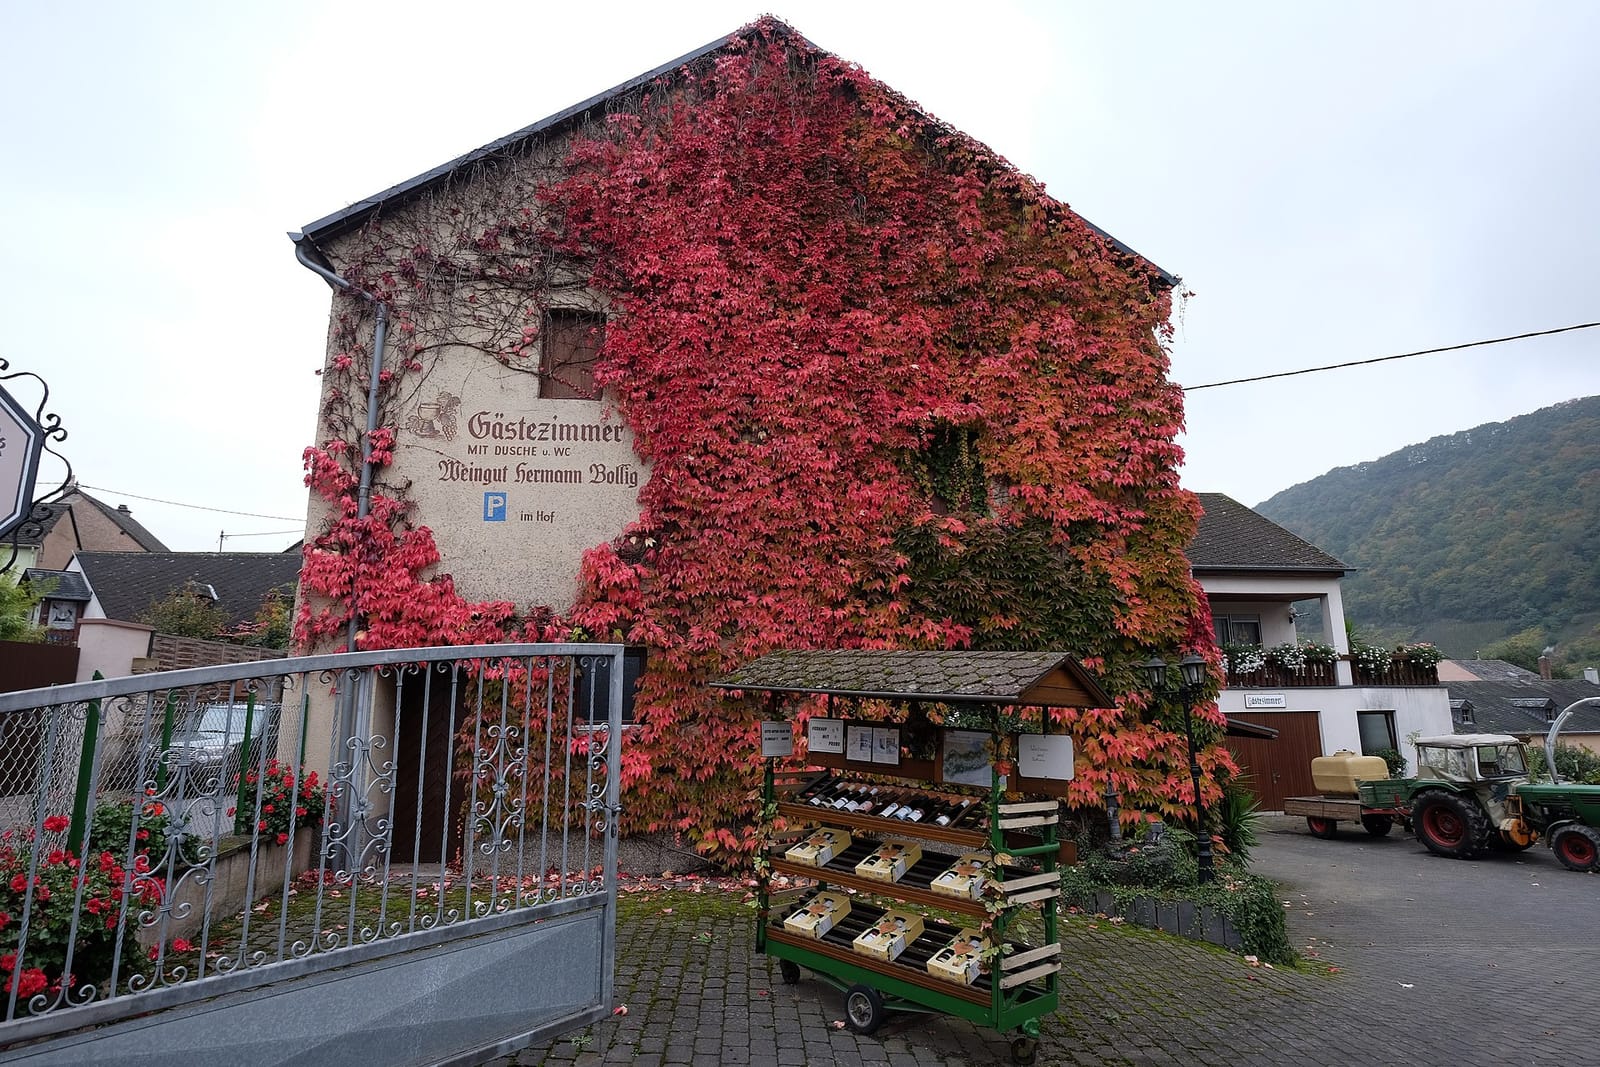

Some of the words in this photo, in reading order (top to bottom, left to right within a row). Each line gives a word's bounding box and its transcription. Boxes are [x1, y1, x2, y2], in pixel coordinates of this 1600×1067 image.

[468, 411, 624, 442] Gästezimmer
[467, 445, 489, 455] MIT
[494, 445, 537, 456] DUSCHE
[553, 447, 571, 457] WC
[438, 459, 508, 486] Weingut
[514, 462, 582, 485] Hermann
[589, 463, 638, 488] Bollig
[487, 495, 505, 518] P
[520, 511, 533, 521] im
[536, 510, 555, 523] Hof
